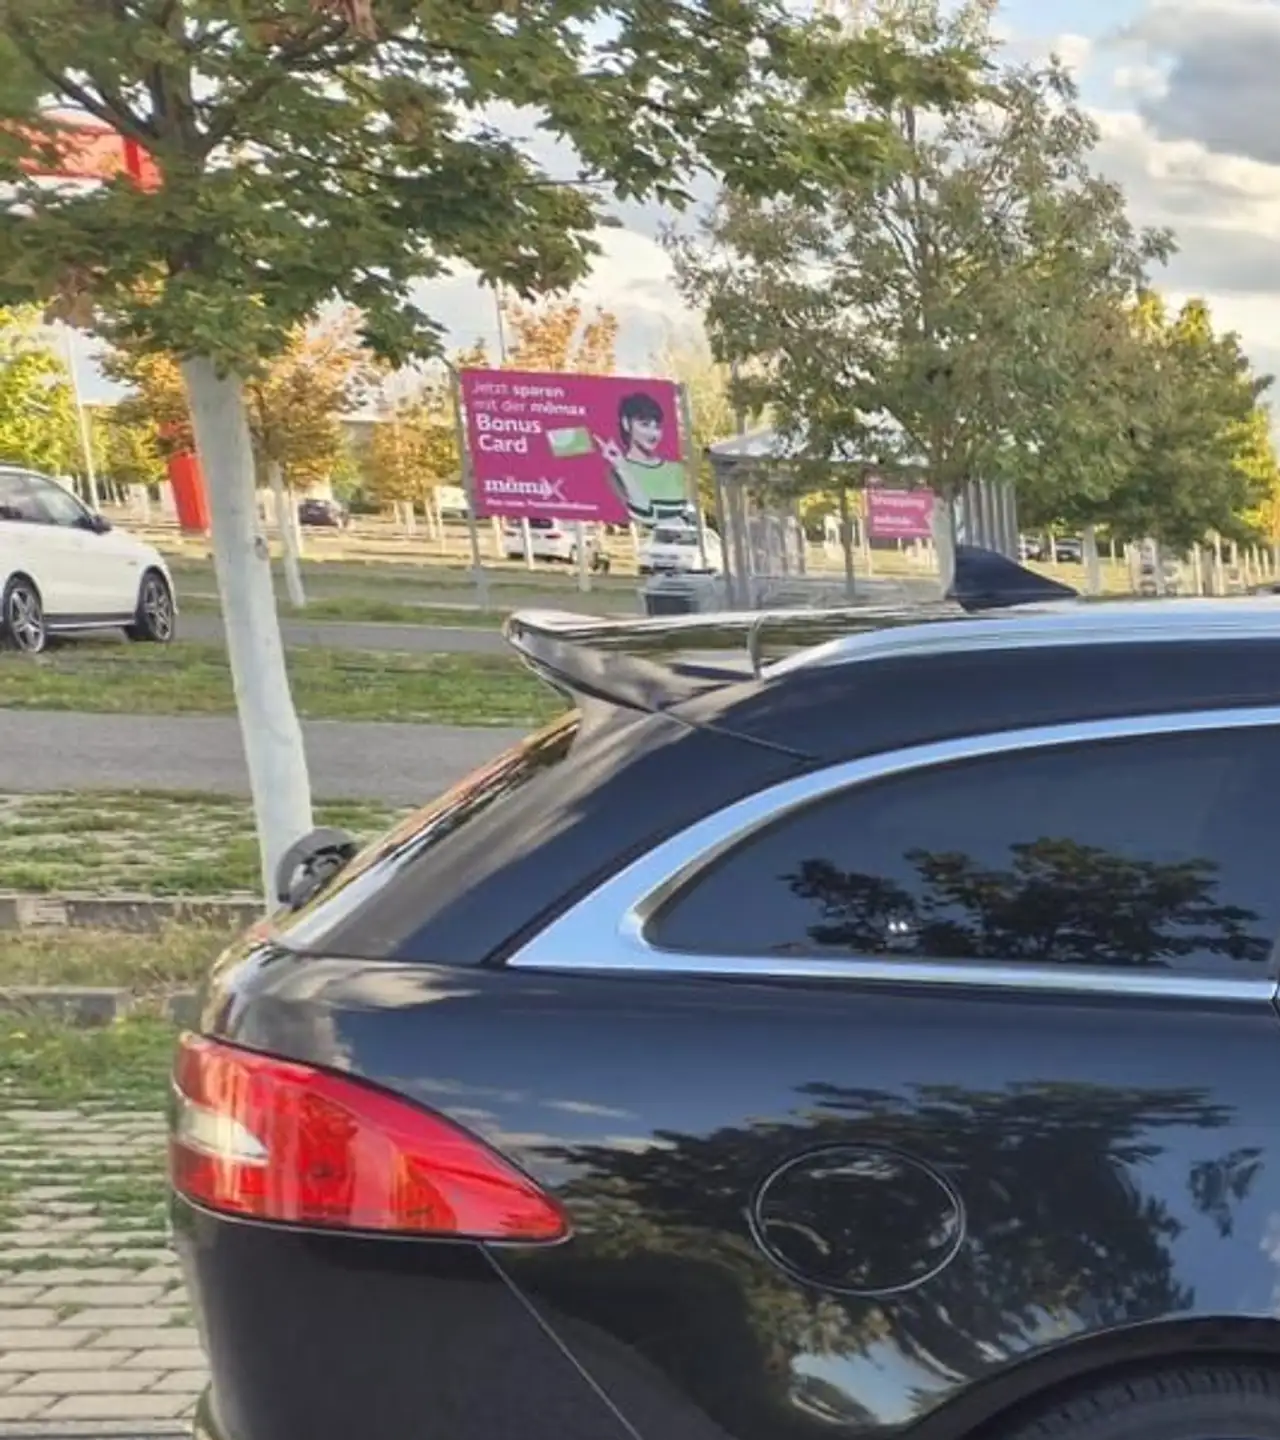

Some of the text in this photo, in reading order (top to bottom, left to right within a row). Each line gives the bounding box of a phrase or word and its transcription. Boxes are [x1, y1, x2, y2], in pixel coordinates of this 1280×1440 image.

[512, 384, 565, 399] sparen
[501, 400, 525, 412] der
[475, 413, 542, 434] Bonus
[478, 433, 528, 453] Card
